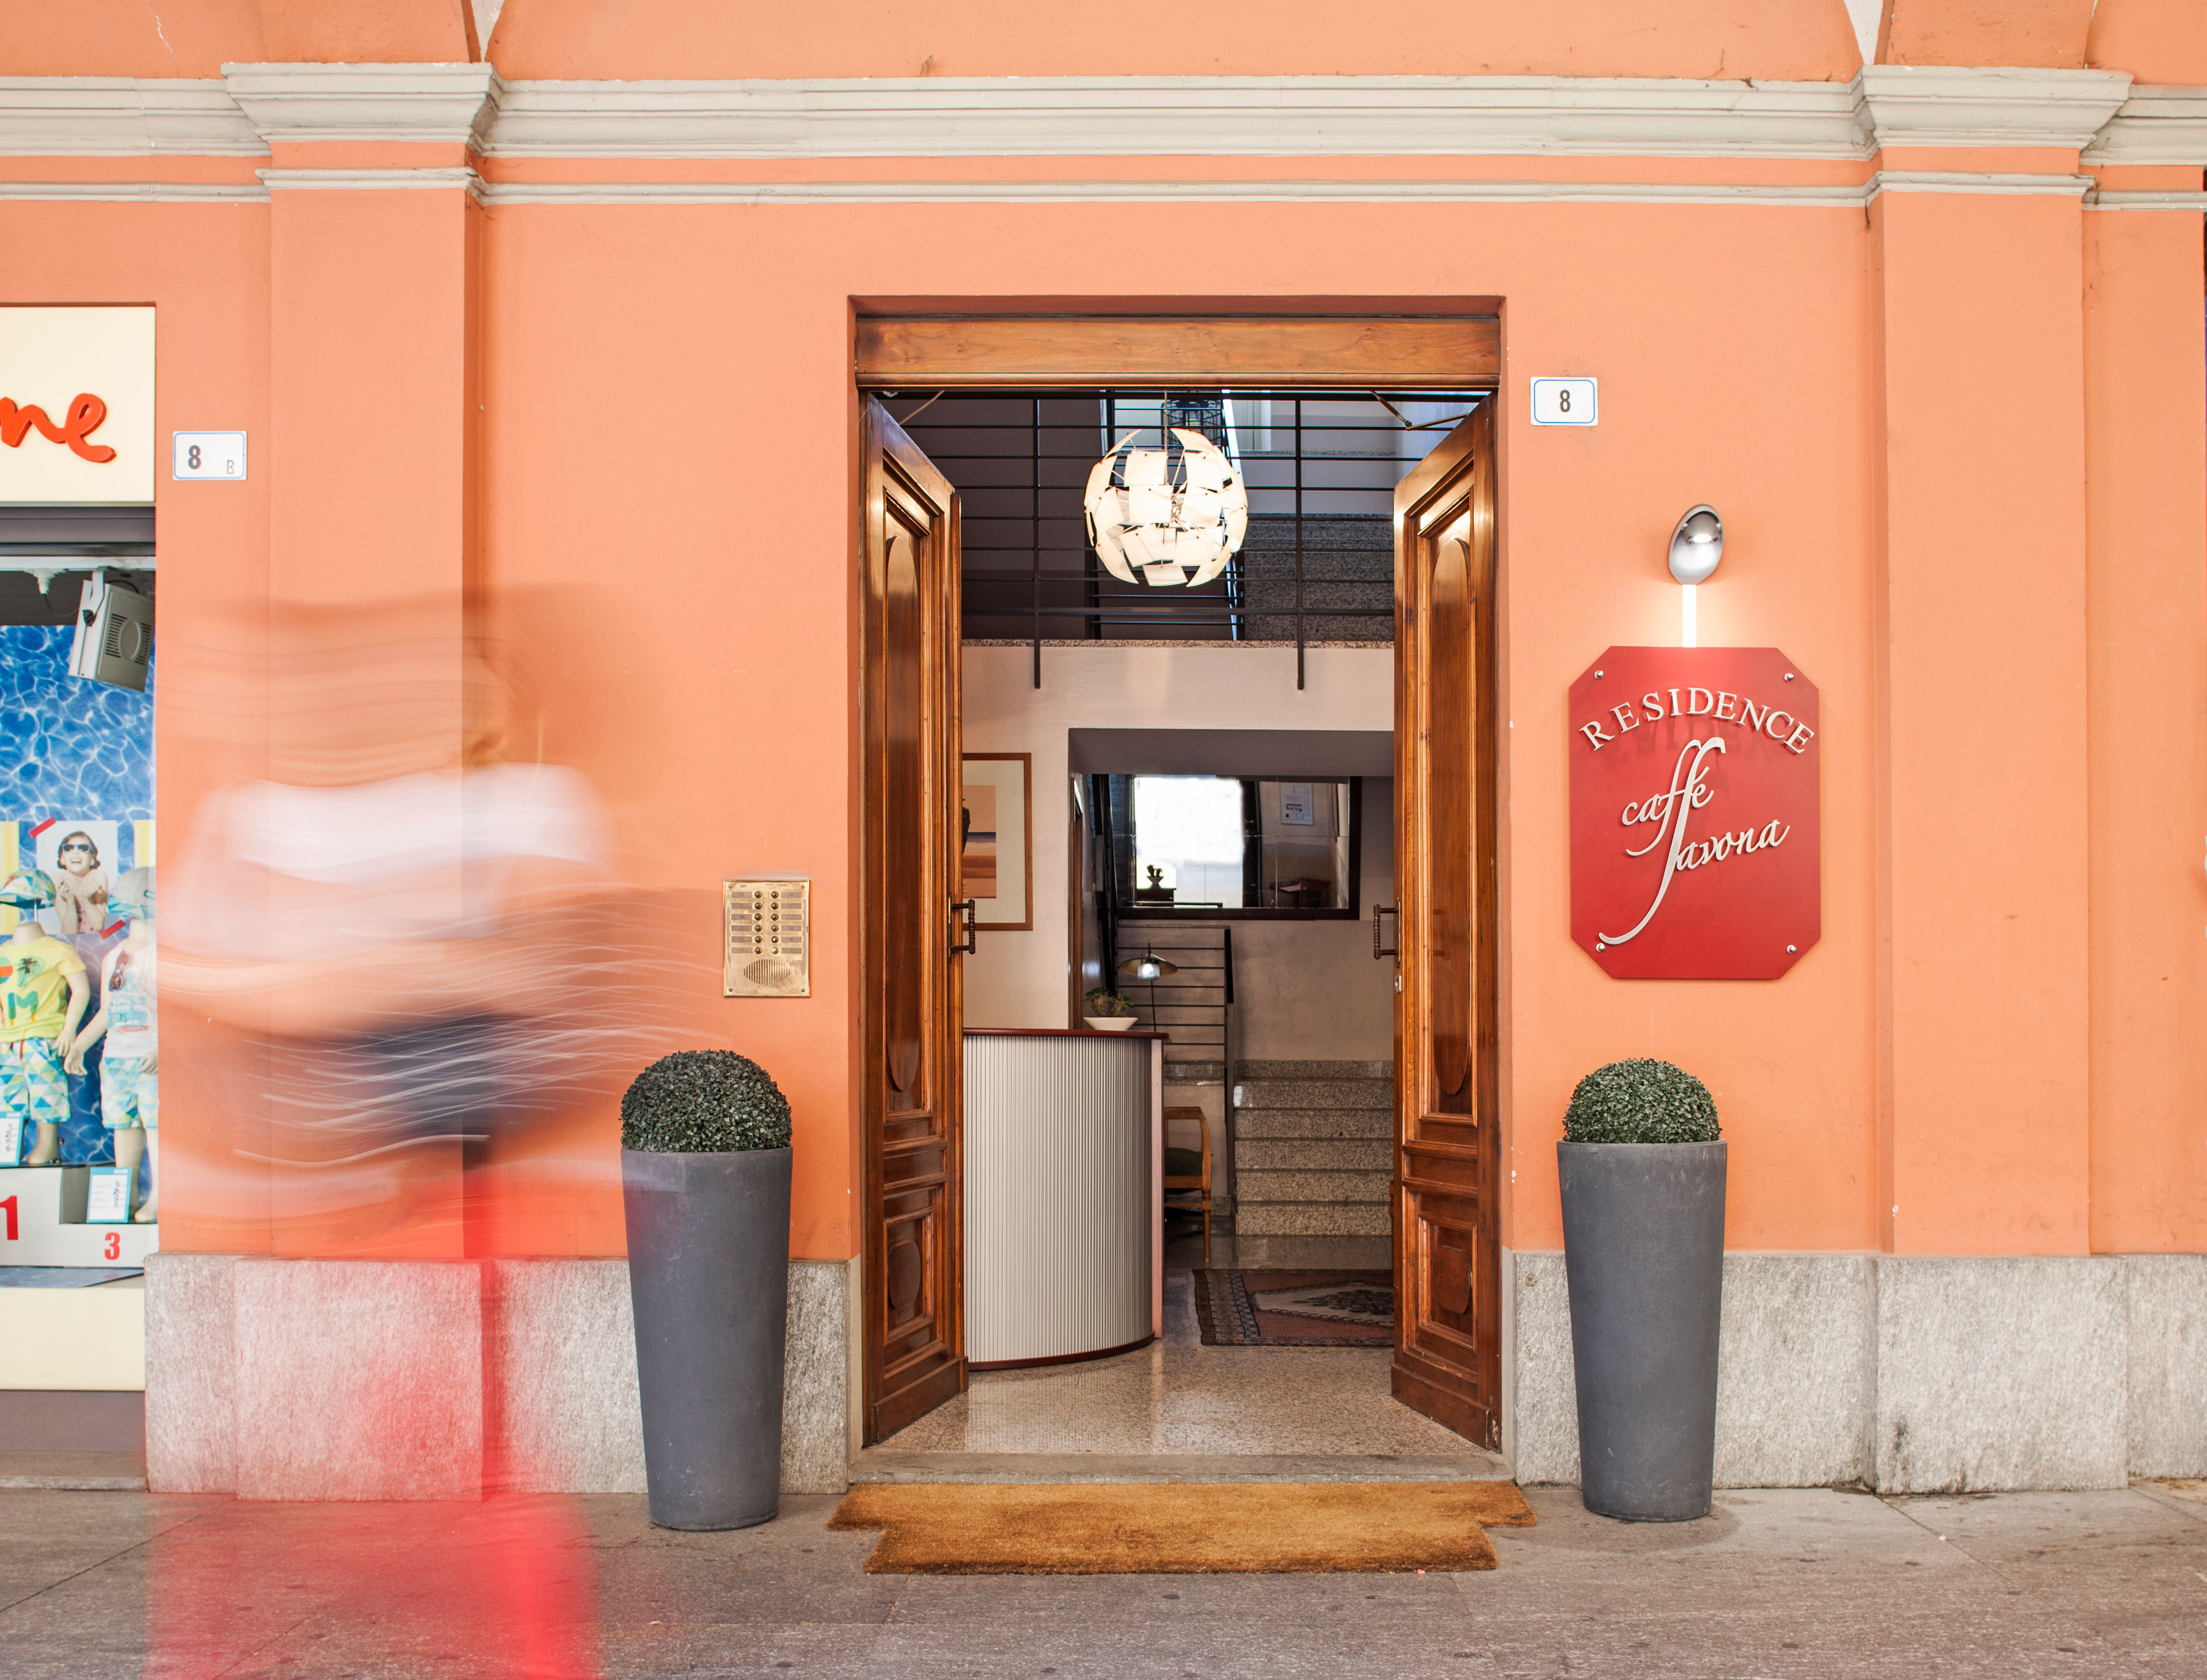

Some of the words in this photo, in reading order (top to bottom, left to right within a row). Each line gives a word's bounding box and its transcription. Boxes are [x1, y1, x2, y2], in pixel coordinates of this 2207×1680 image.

[1560, 389, 1570, 413] 8
[188, 445, 201, 469] 8
[227, 460, 235, 474] B
[1579, 687, 1815, 754] RESIDENCE
[0, 1195, 18, 1240] 1
[104, 1232, 120, 1260] 3
